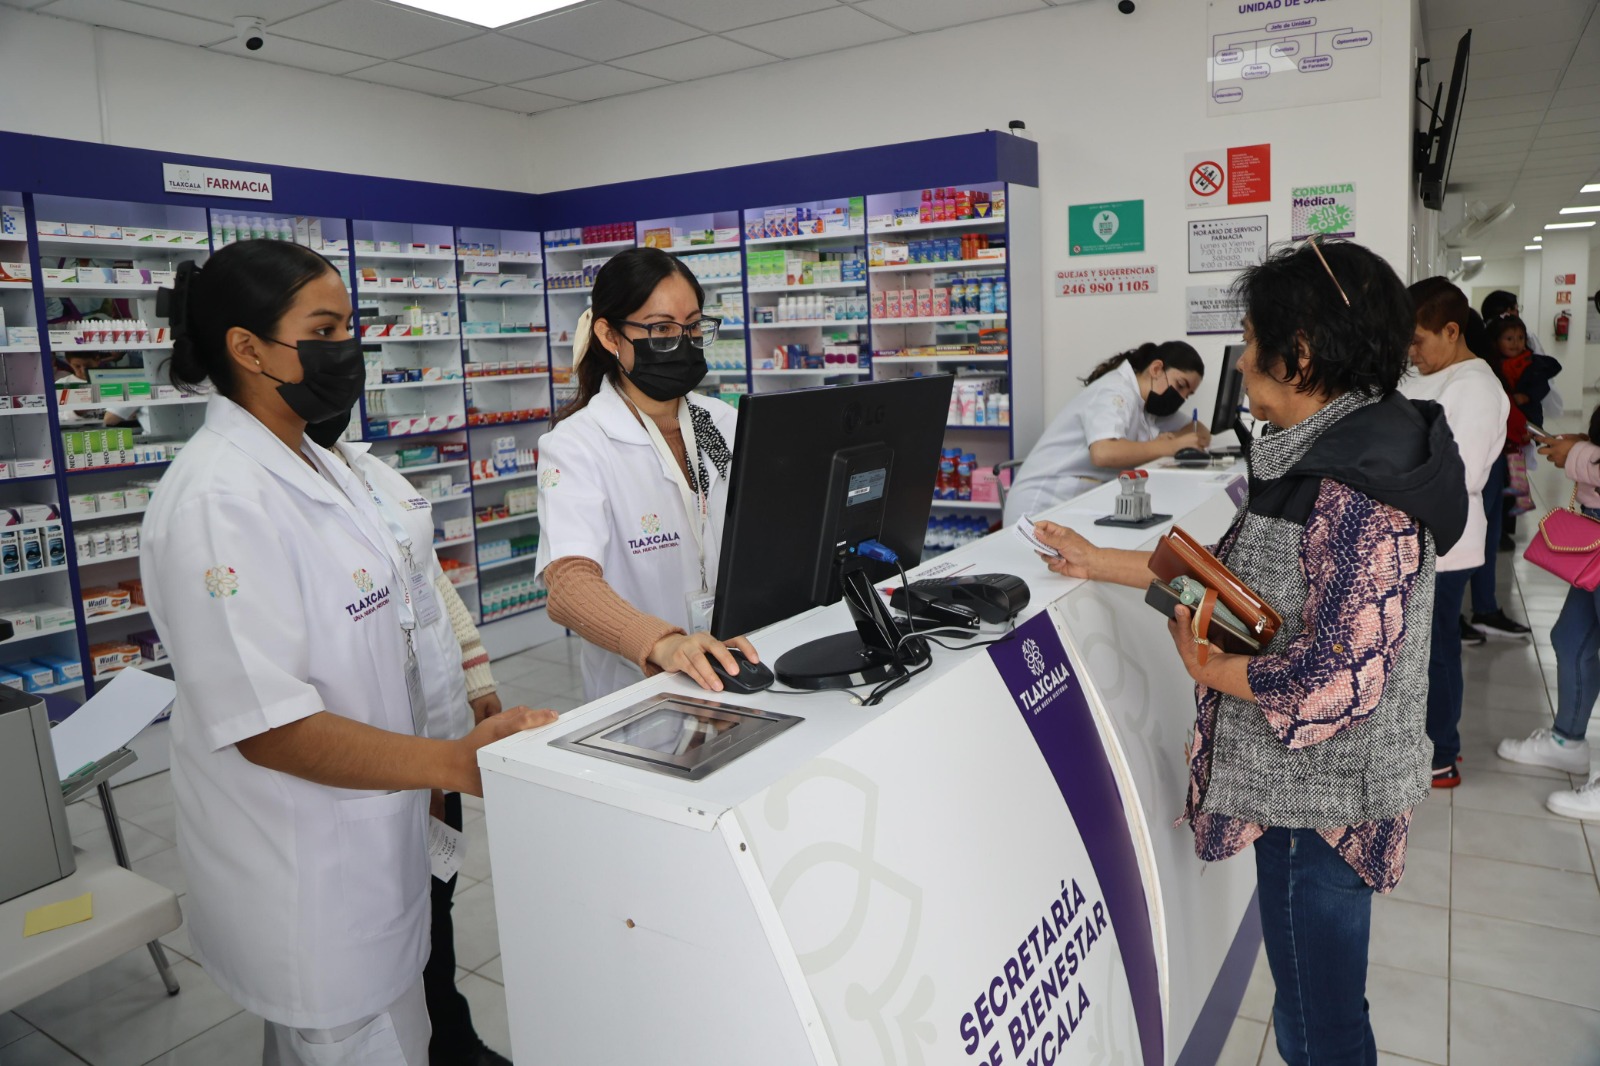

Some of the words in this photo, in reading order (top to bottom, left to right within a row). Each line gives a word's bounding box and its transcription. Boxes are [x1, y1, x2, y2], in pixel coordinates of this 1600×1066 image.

[1238, 0, 1281, 14] UNIDAD
[1303, 57, 1328, 65] Encargado
[169, 180, 201, 189] TLAXCALA
[206, 177, 270, 193] FARMACIA
[1293, 184, 1354, 197] CONSULTA
[1293, 197, 1336, 207] Médica
[1316, 206, 1337, 220] SIN
[1311, 212, 1352, 231] COSTO
[1193, 229, 1223, 237] HORARIO
[1234, 225, 1262, 233] SERVICIO
[1200, 242, 1220, 250] Lunes
[1057, 271, 1089, 279] QUEJAS
[1098, 266, 1155, 276] SUGERENCIAS
[1062, 284, 1086, 294] 246
[1089, 282, 1113, 293] 980
[1118, 280, 1149, 291] 1105
[865, 405, 886, 426] LG
[628, 531, 680, 549] TLAXCALA
[642, 545, 657, 553] NUEVA
[345, 586, 390, 616] TLAXCALA
[1019, 662, 1070, 711] TLAXCALA
[1033, 706, 1042, 715] UNA
[1041, 696, 1053, 709] NUEVA
[1052, 683, 1068, 699] HISTORIA
[960, 878, 1086, 1055] SECRETARÍA
[1008, 900, 1107, 1060] BIENESTAR
